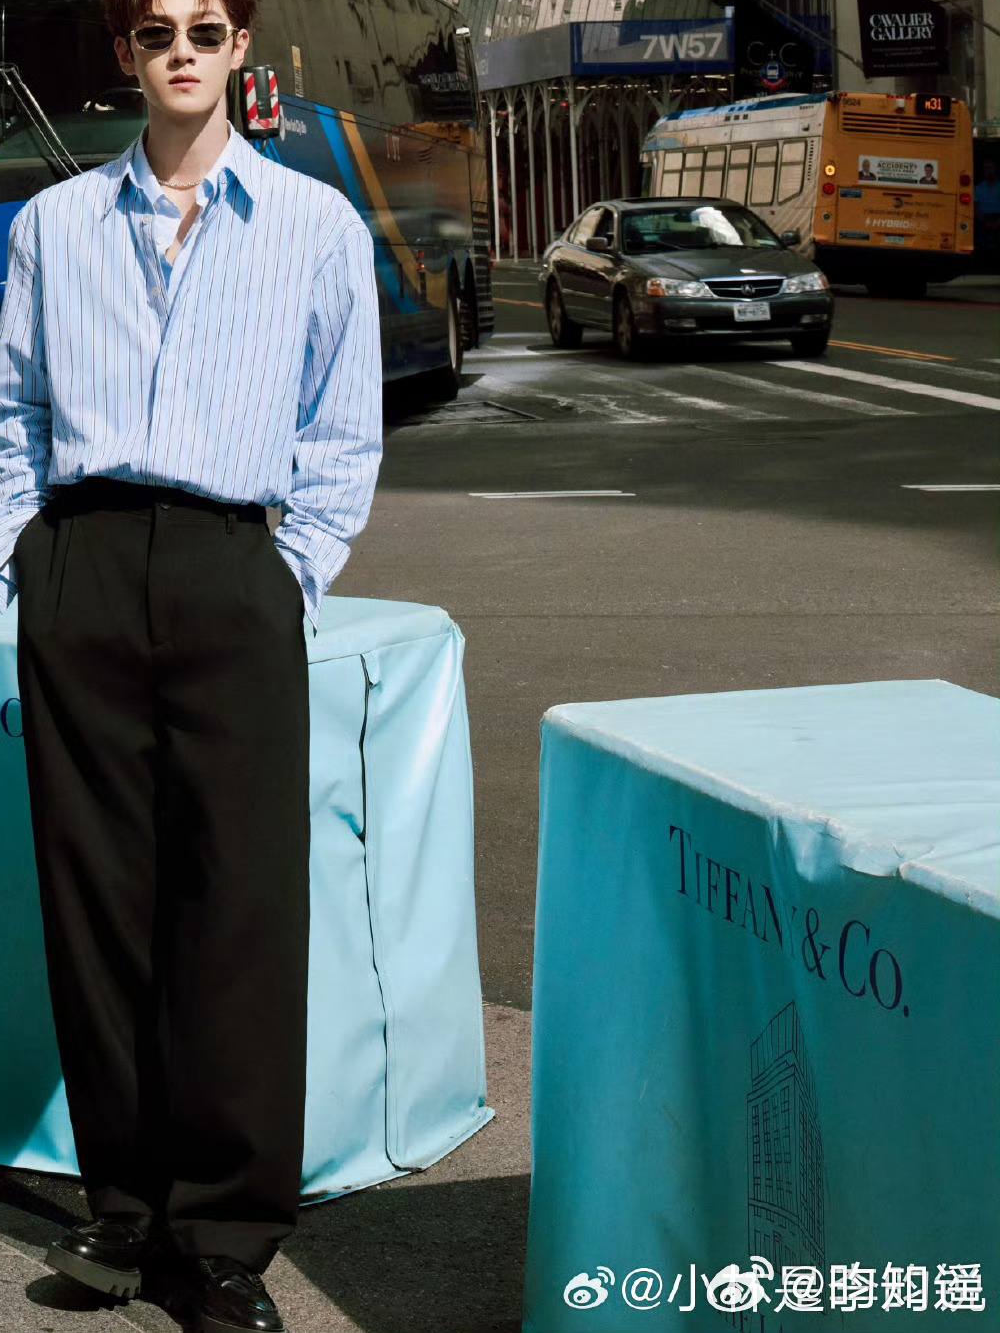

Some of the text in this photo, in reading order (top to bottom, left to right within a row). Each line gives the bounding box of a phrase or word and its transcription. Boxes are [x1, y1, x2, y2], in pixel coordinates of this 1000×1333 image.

[869, 12, 934, 27] CAVALIER
[871, 26, 934, 40] GALLERY
[640, 32, 723, 59] 7W57
[925, 97, 942, 110] M31
